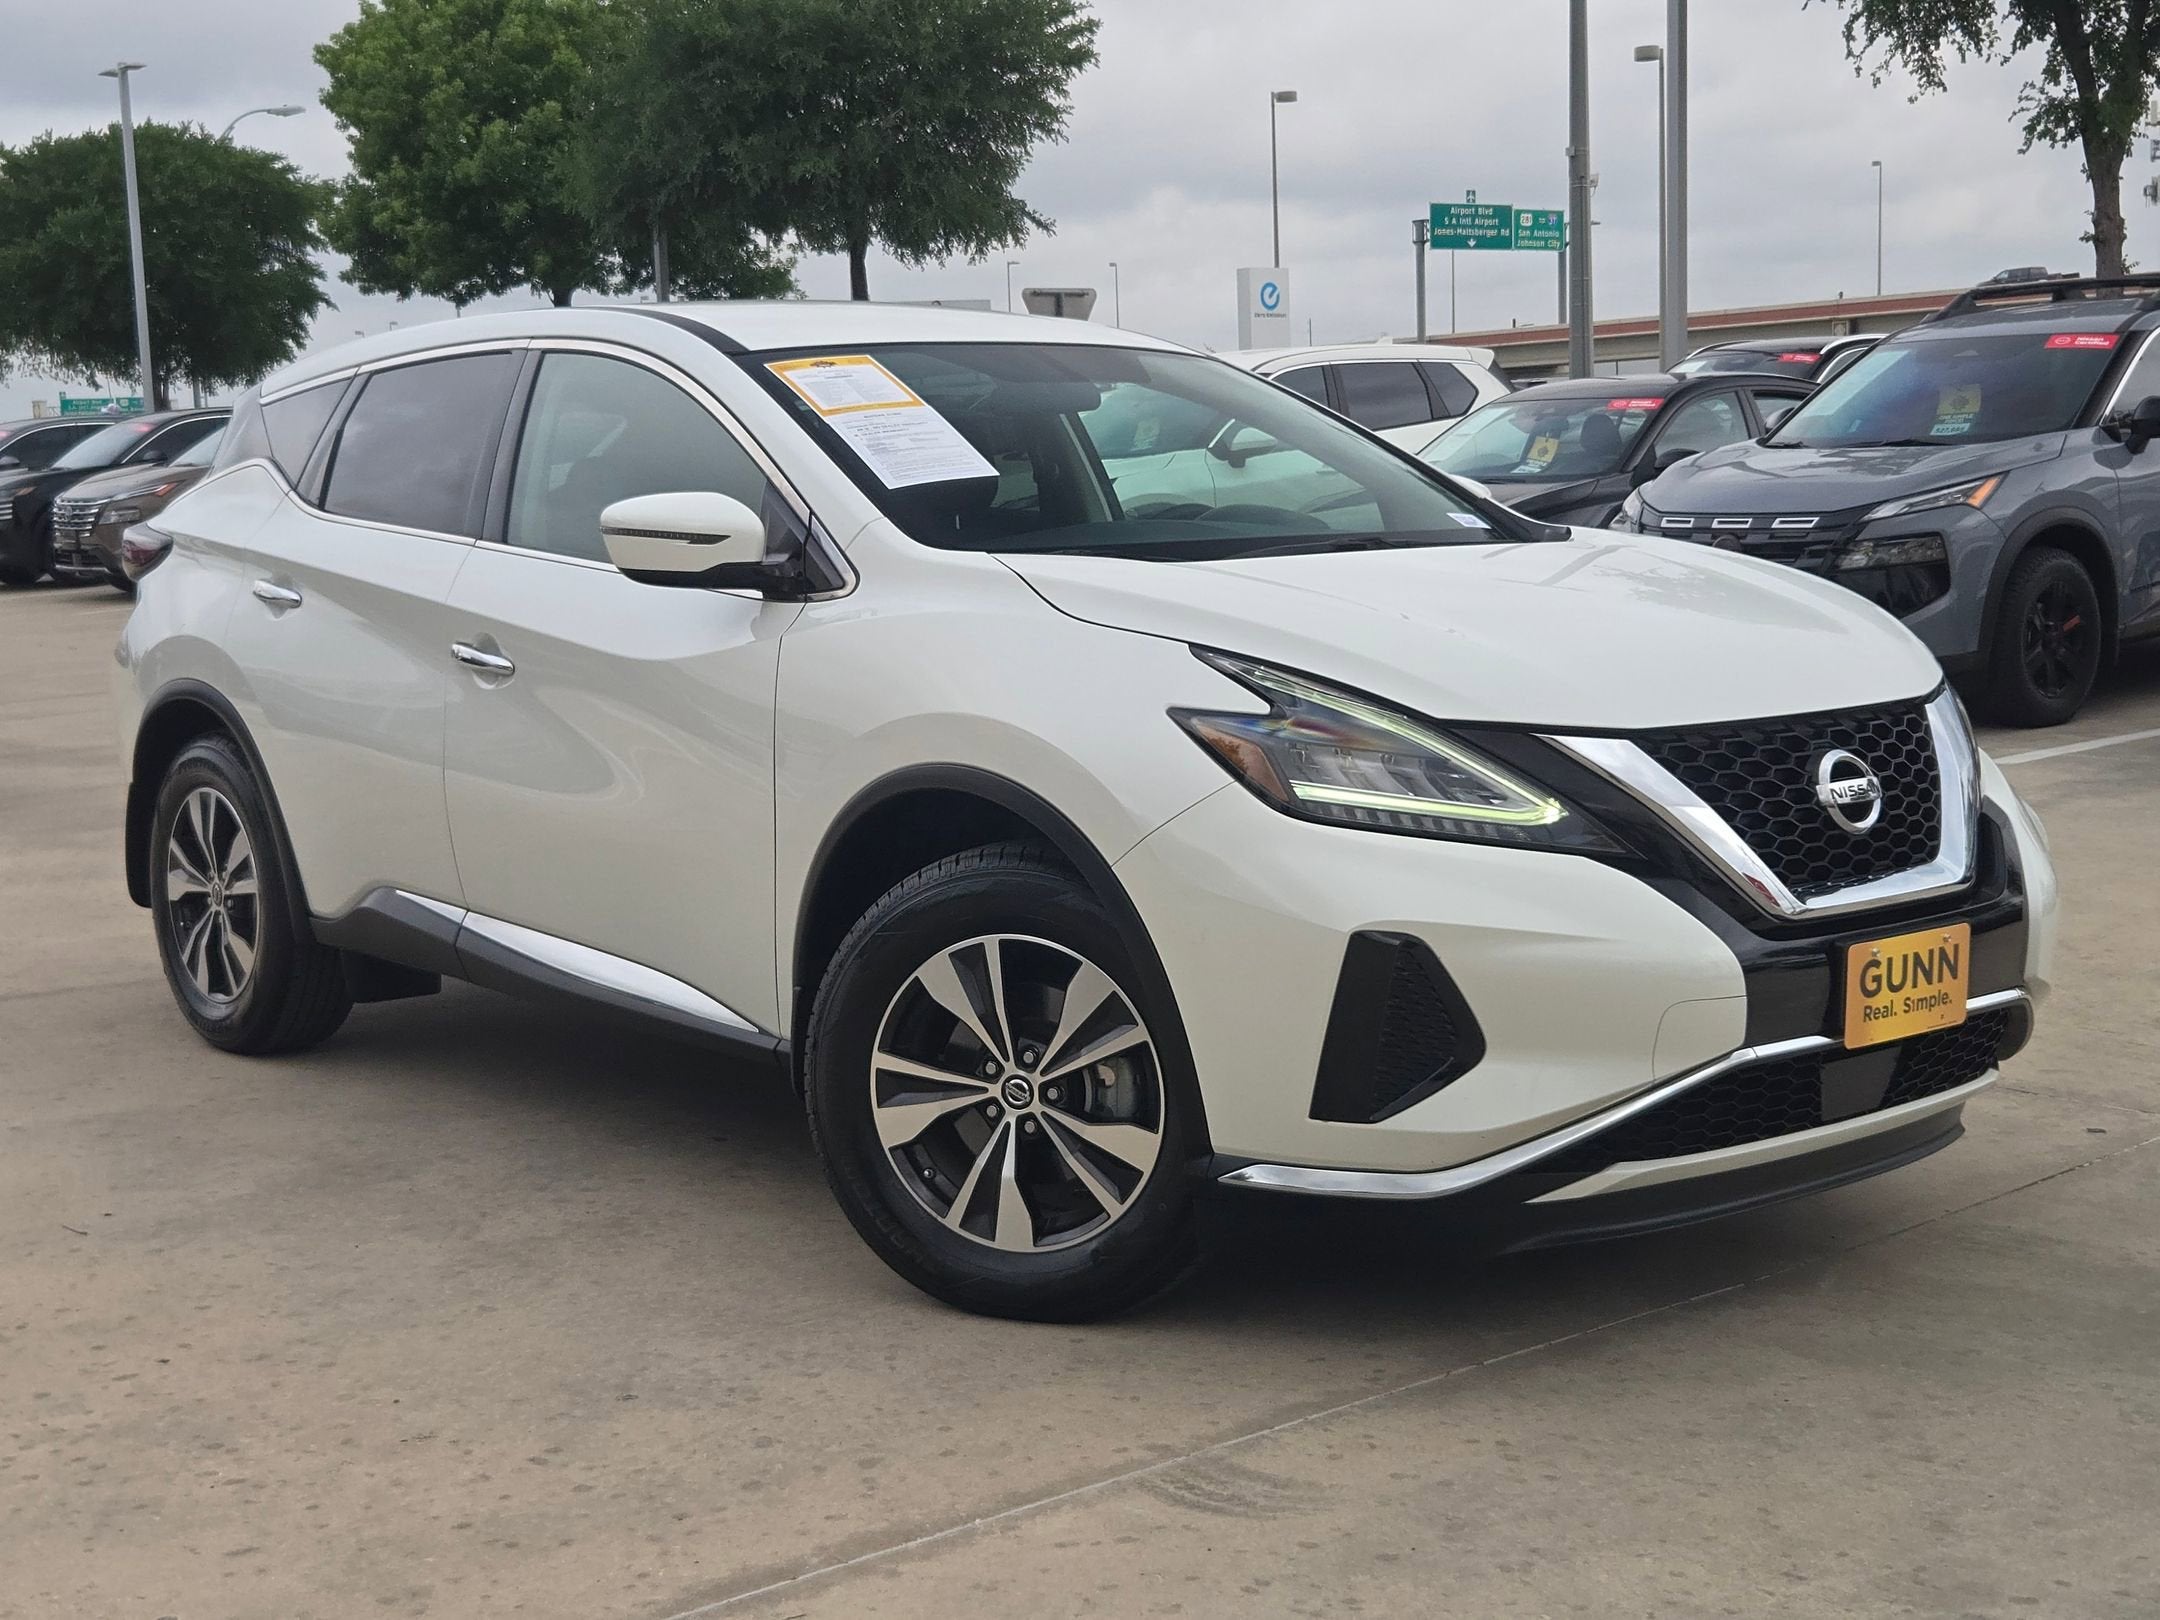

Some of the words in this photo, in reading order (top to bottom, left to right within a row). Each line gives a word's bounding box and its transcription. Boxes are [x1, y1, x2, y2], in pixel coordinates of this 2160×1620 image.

[1450, 206, 1475, 216] Airport
[1477, 207, 1493, 215] Blvd
[1444, 217, 1449, 225] S
[1451, 217, 1457, 225] A
[1474, 217, 1499, 227] Airport
[1520, 215, 1532, 224] 281
[1434, 227, 1498, 238] Jones-Maltsberger
[1500, 228, 1510, 236] Rd
[1518, 229, 1531, 238] San
[1533, 229, 1560, 238] Antonio
[1517, 239, 1545, 248] Johnson
[1547, 239, 1561, 249] City
[1859, 943, 1960, 998] GUNN
[1863, 999, 1898, 1023] Real.
[1903, 989, 1953, 1015] Simple.
